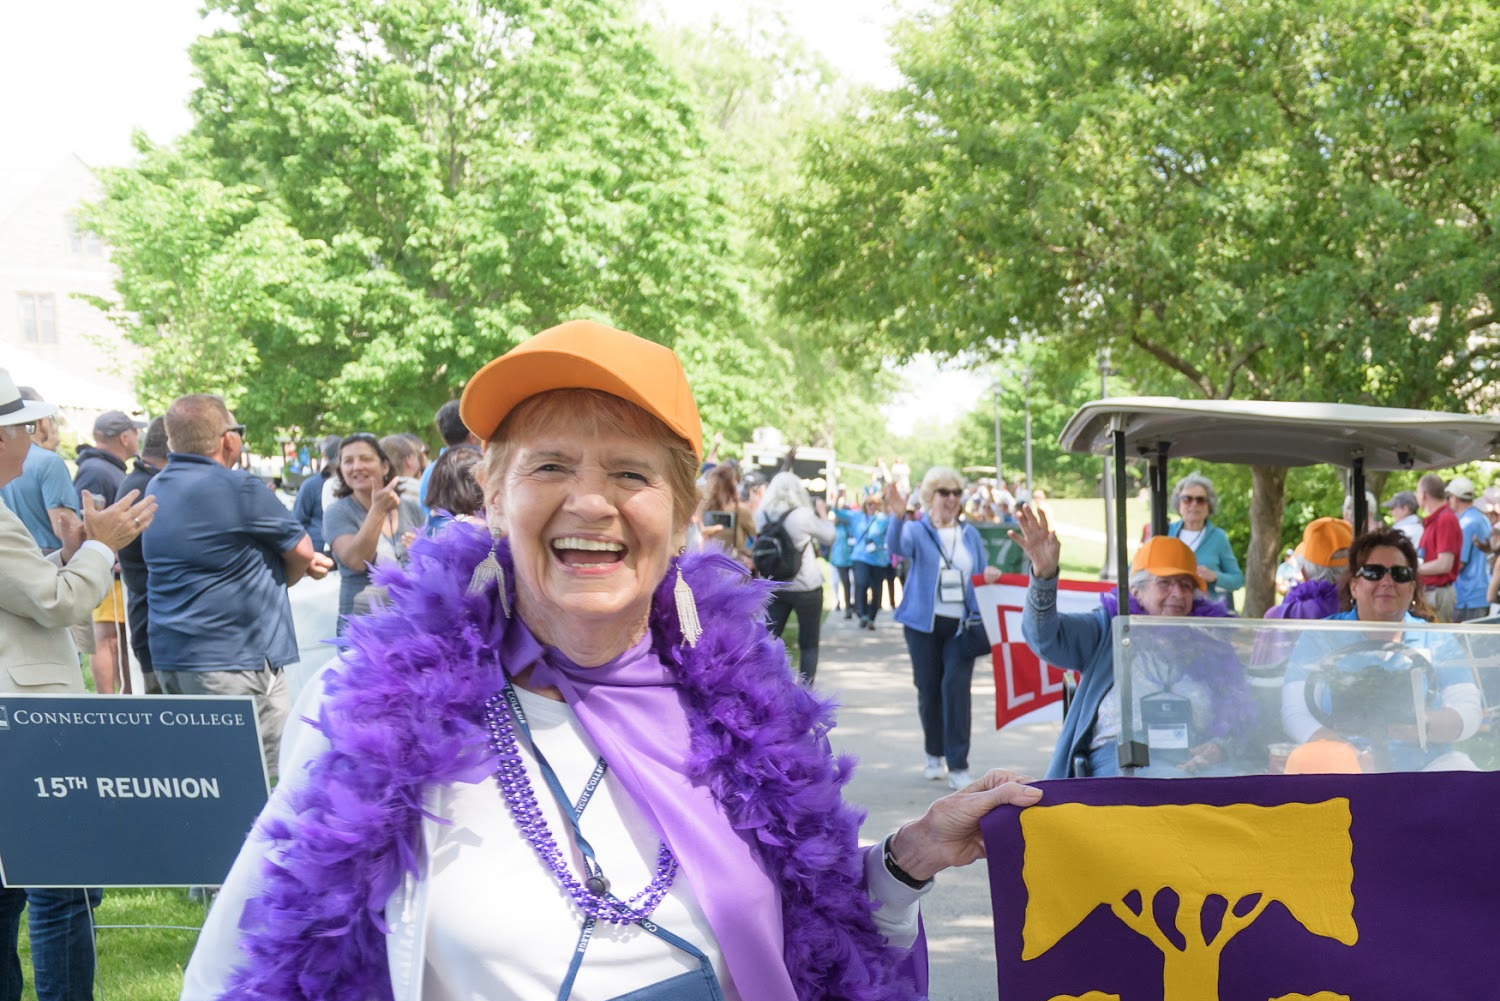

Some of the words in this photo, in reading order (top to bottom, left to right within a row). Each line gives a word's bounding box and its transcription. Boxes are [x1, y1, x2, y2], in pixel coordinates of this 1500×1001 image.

[13, 709, 153, 726] CONNECTICUT
[159, 711, 245, 726] COLLEGE
[96, 777, 220, 798] REUNION
